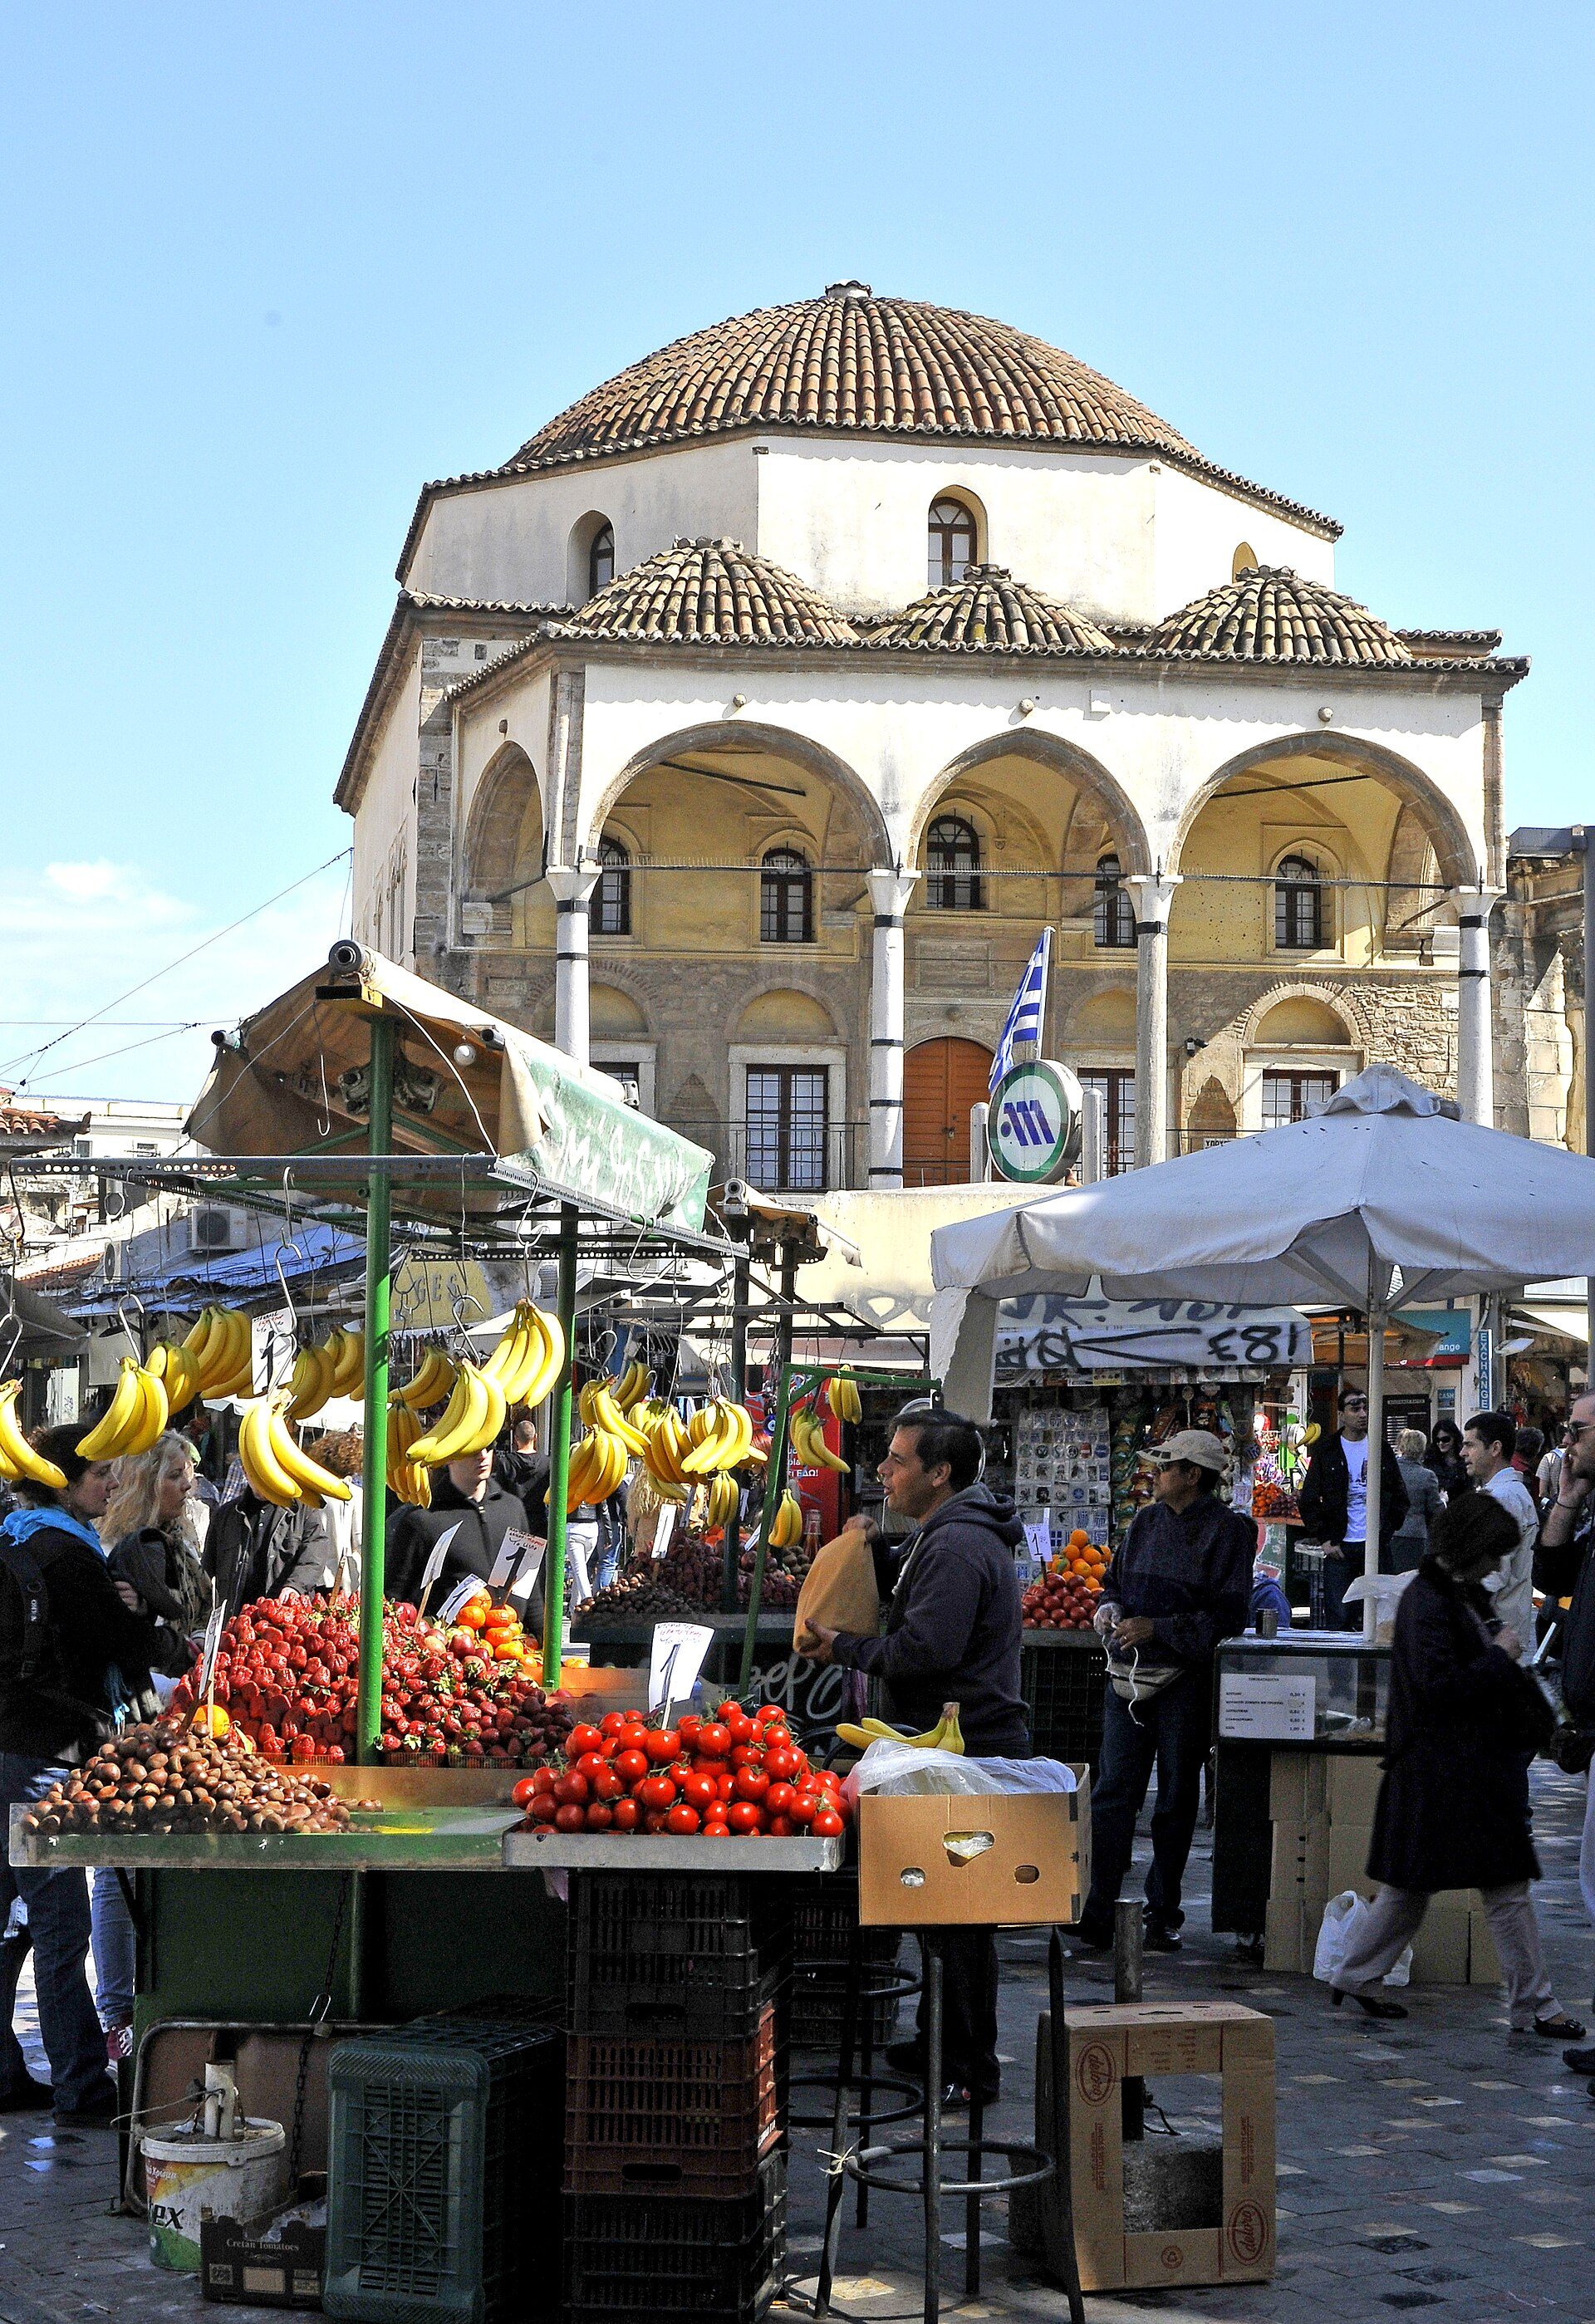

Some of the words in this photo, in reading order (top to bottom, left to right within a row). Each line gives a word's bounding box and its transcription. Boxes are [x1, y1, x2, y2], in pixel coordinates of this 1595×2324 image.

[1437, 1342, 1460, 1352] ange
[1480, 1332, 1489, 1409] EXCHANGE
[1032, 1532, 1043, 1556] 1
[503, 1546, 528, 1588] 1
[655, 1643, 681, 1709] 1
[226, 2238, 255, 2248] Cretan
[259, 2241, 300, 2251] Tomatoes
